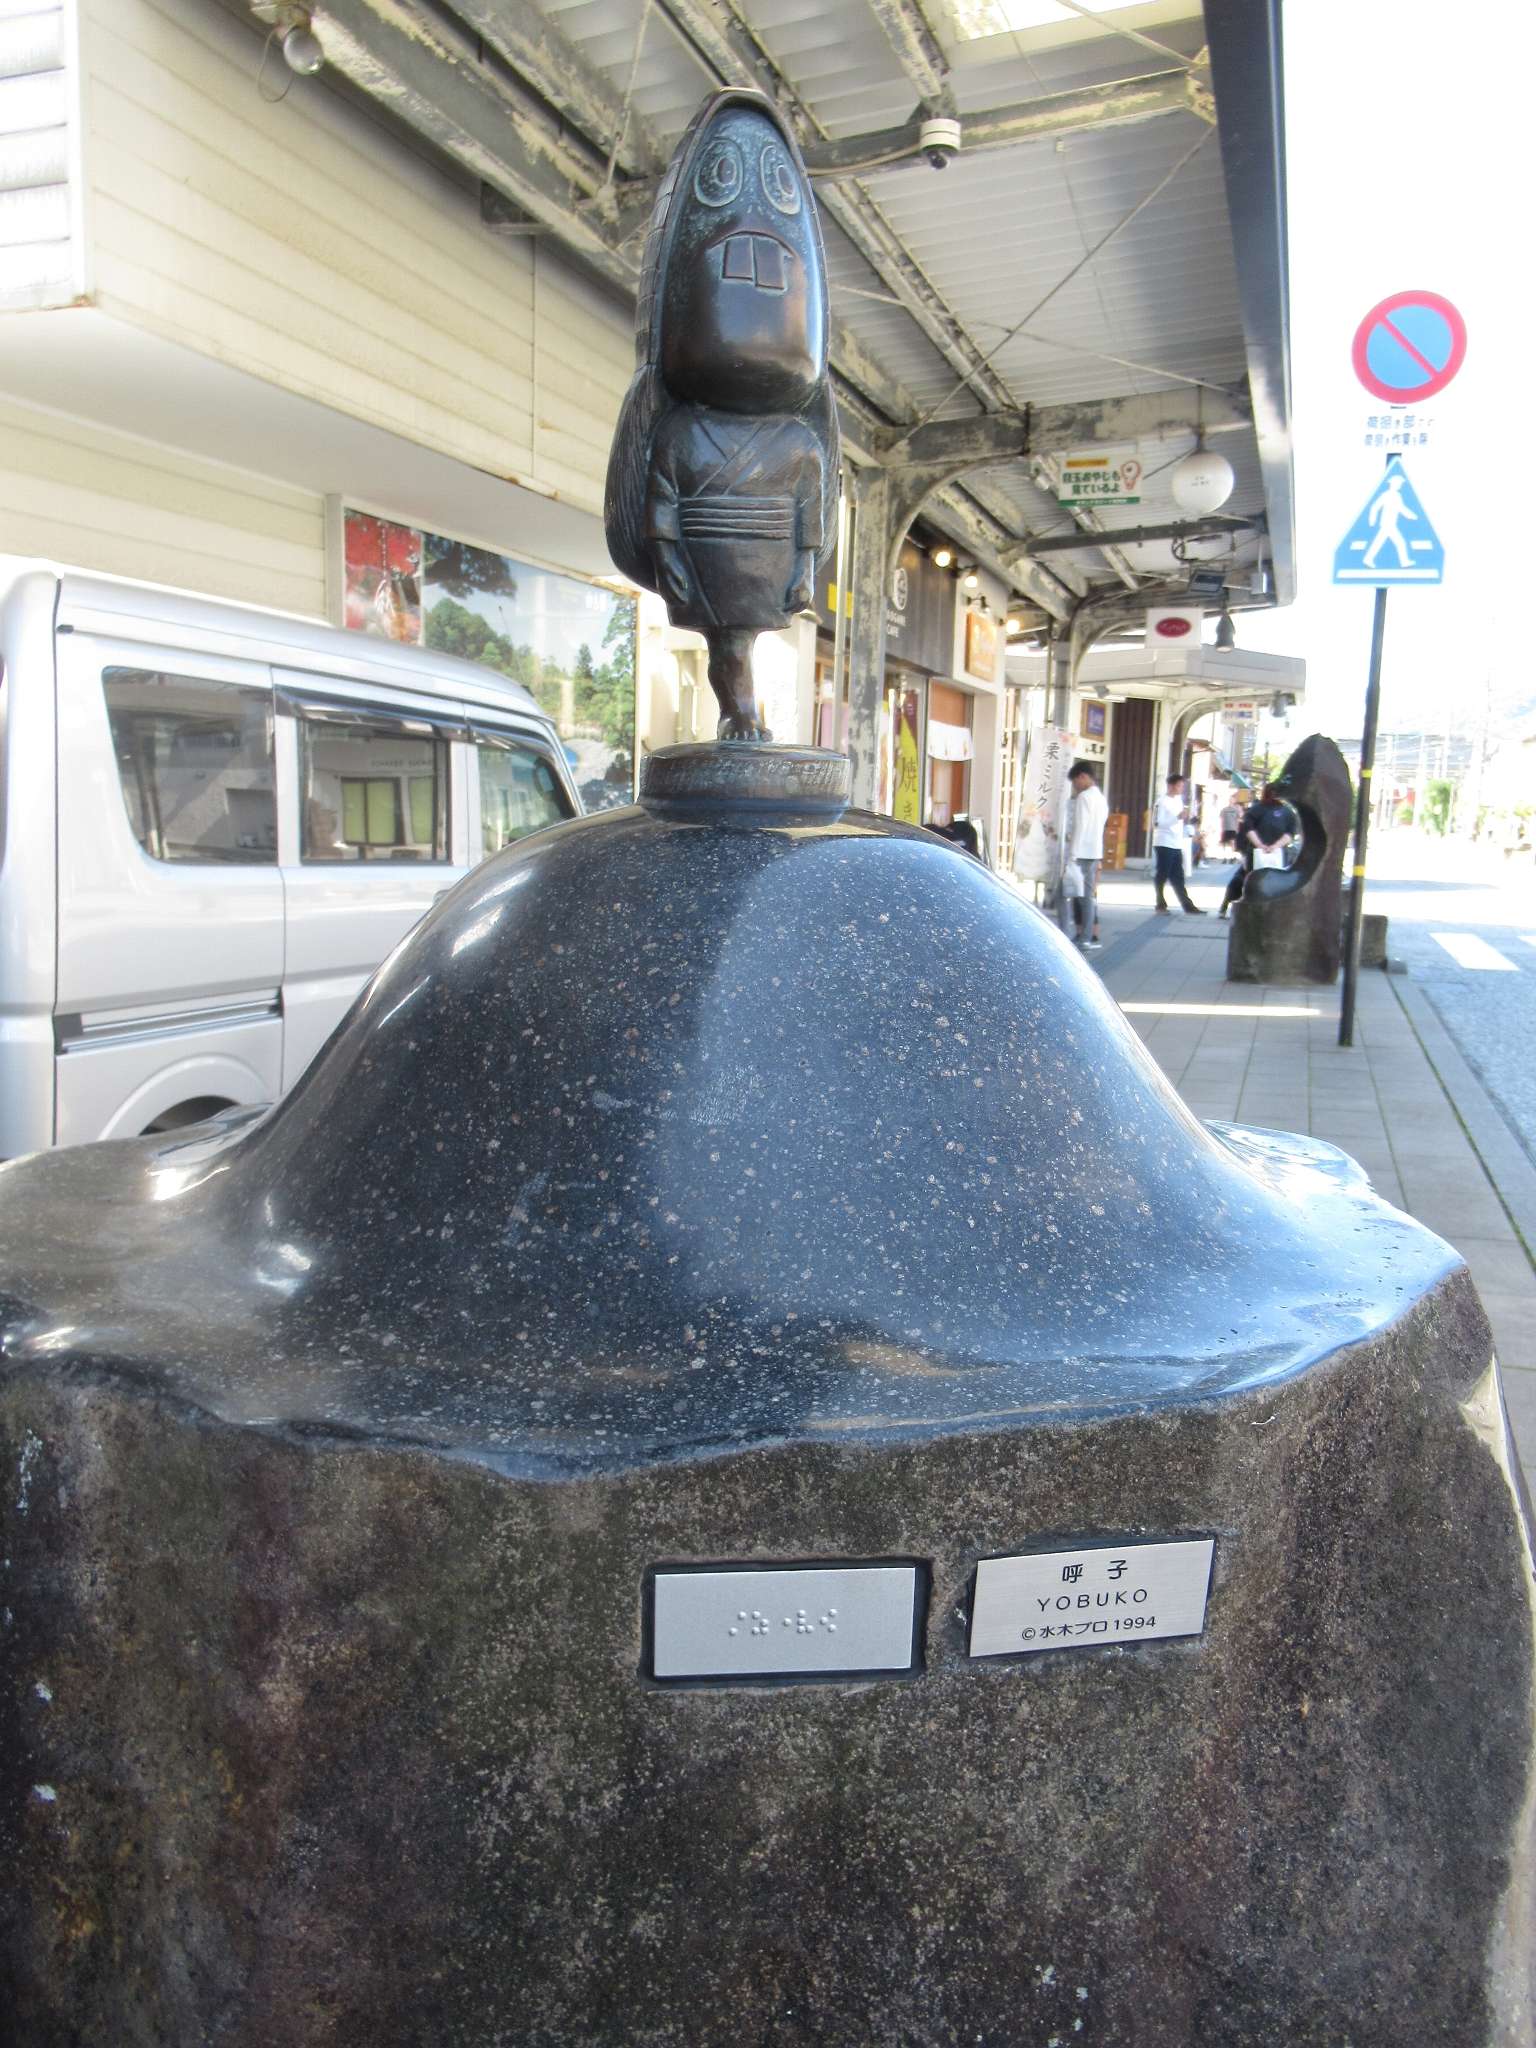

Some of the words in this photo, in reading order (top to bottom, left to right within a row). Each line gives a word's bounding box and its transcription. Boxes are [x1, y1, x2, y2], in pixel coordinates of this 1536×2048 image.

[1063, 470, 1120, 483] 目玉おやじも
[1072, 483, 1120, 495] 見ているよ
[1036, 742, 1060, 809] 栗ミルク
[1036, 1588, 1149, 1613] YOBUKO
